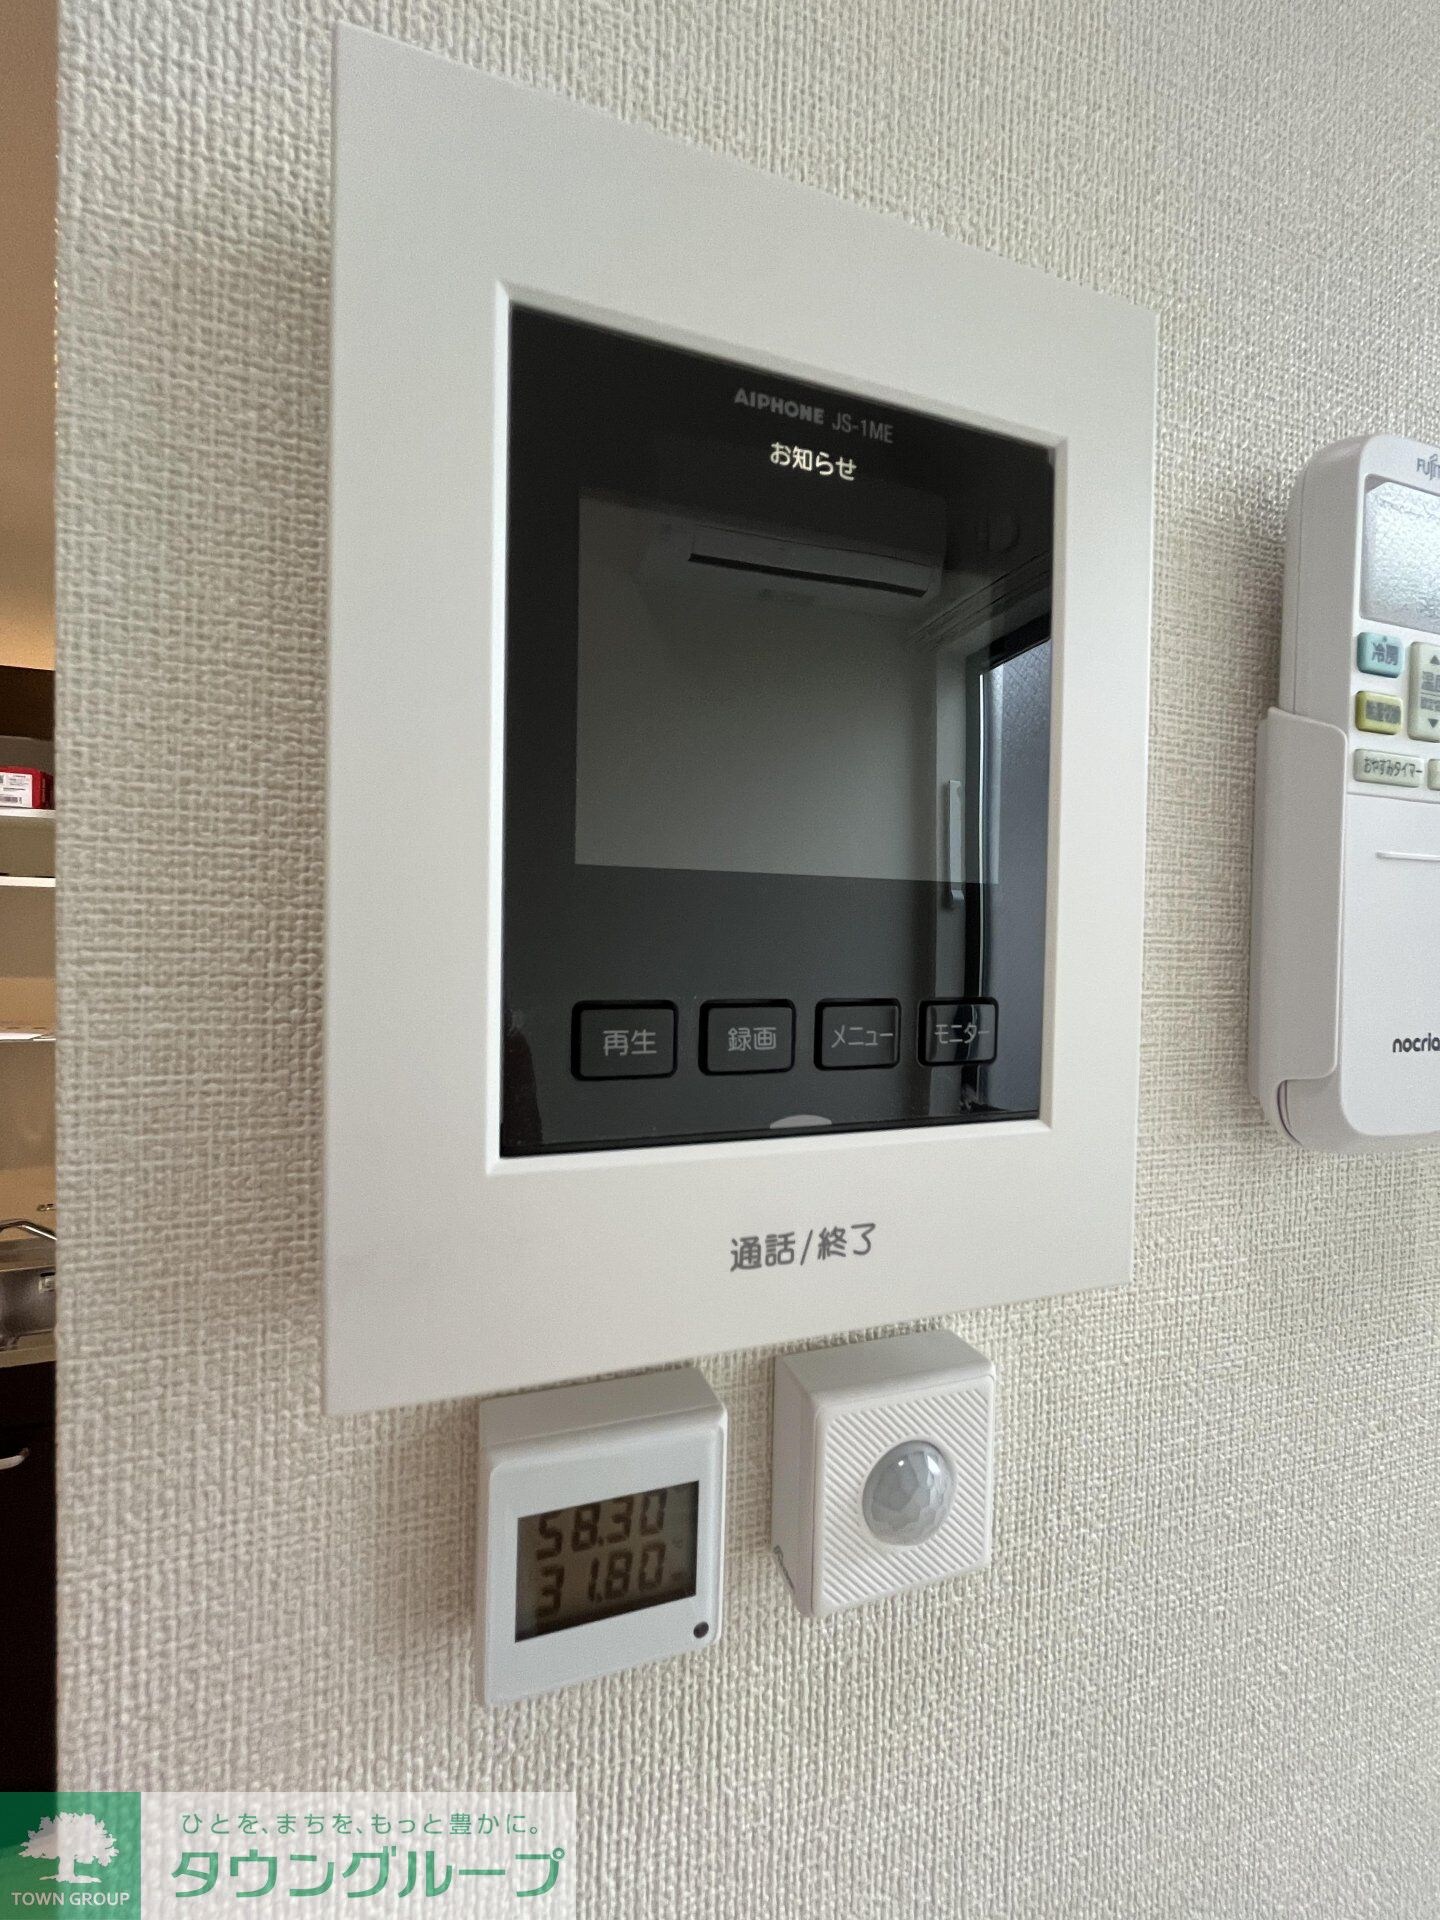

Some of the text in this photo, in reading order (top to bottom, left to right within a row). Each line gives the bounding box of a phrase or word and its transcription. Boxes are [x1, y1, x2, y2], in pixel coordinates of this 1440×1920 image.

[734, 387, 895, 444] AIPHONE JS-1ME
[769, 441, 858, 481] お知らせ
[602, 1028, 658, 1056] 再生
[727, 1026, 777, 1053] 録画
[830, 1024, 894, 1049] メニュー
[933, 1023, 991, 1046] モニター
[729, 1222, 877, 1272] 通話/終了
[536, 1487, 668, 1561] 58.30
